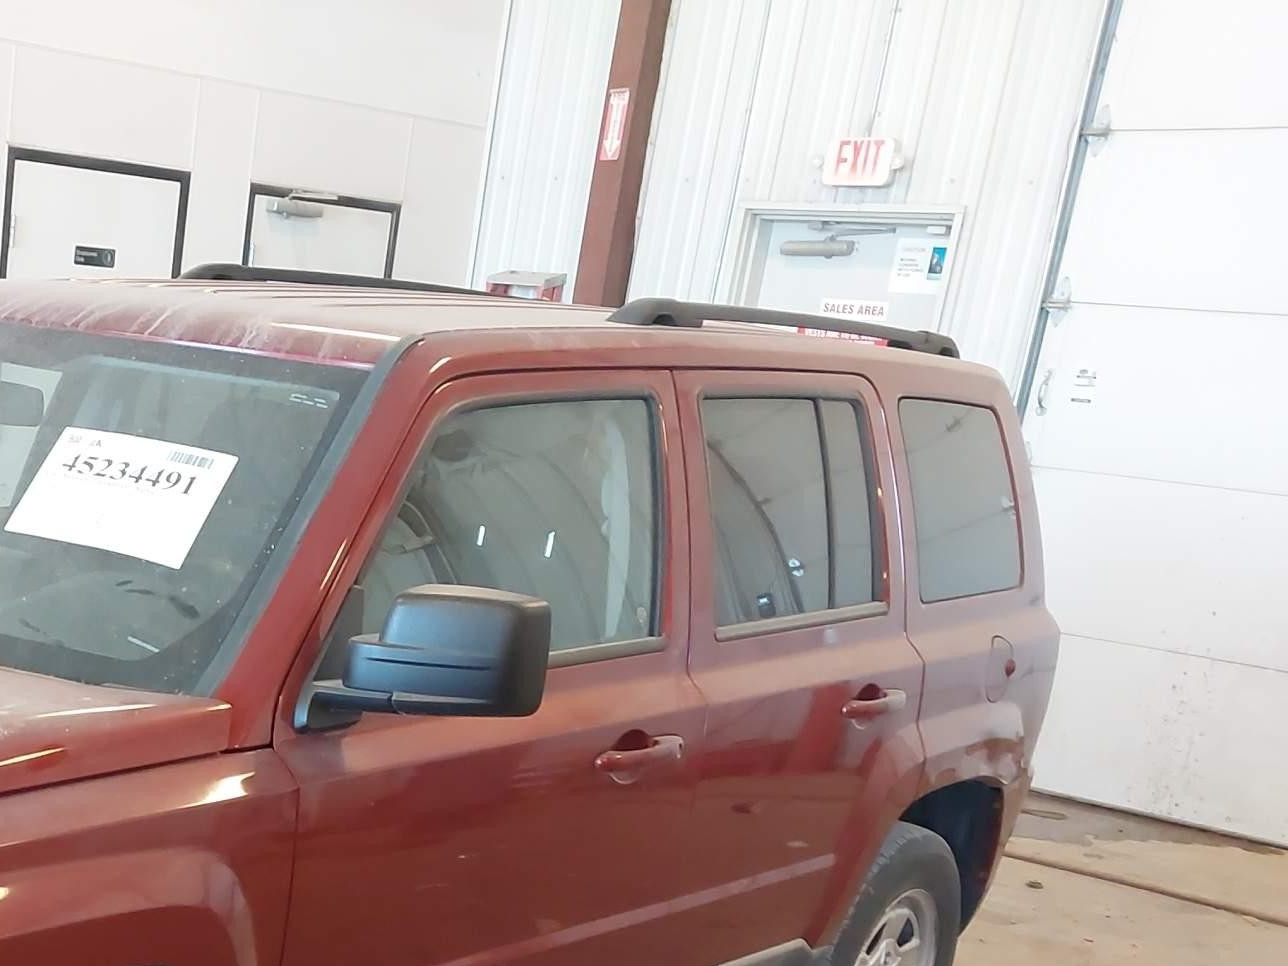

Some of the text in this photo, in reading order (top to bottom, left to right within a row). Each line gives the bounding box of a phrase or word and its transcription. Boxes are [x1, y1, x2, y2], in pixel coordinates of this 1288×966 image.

[834, 139, 886, 177] EXIT
[823, 303, 884, 317] SALES AREA
[62, 454, 197, 495] 45234491
